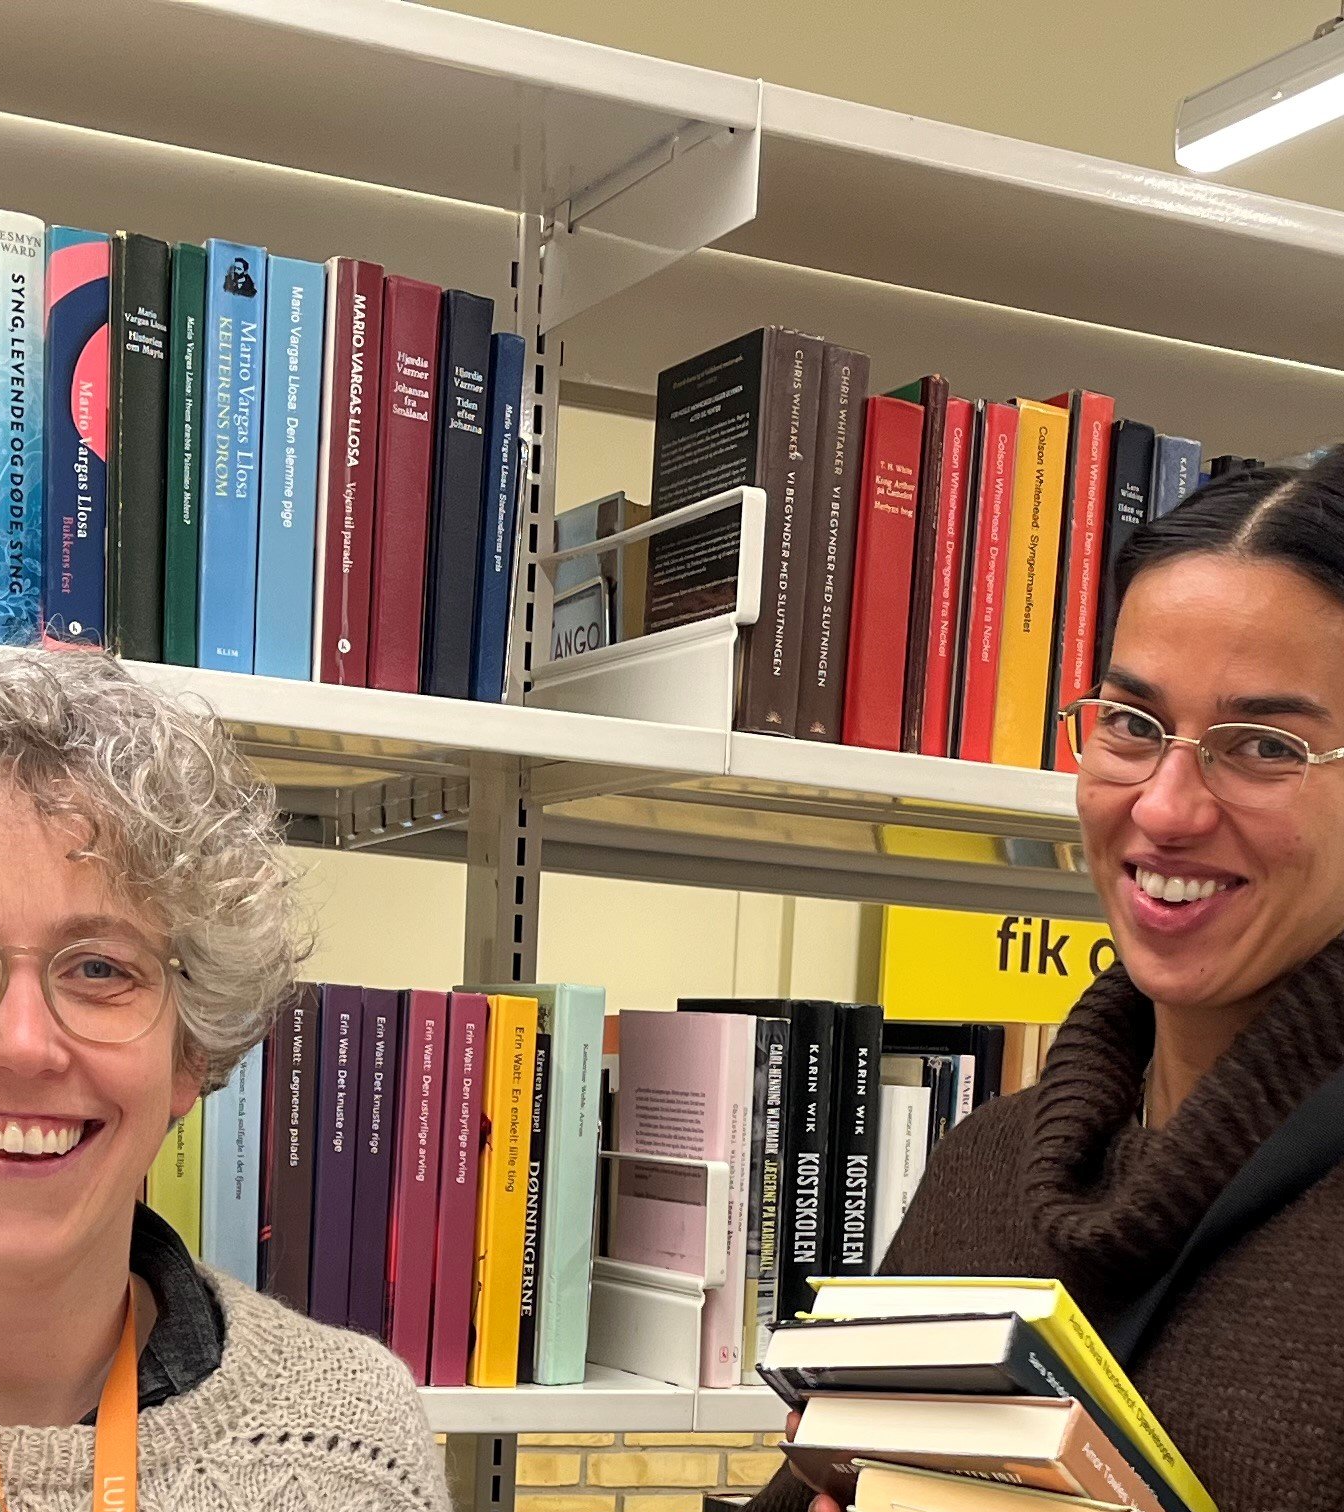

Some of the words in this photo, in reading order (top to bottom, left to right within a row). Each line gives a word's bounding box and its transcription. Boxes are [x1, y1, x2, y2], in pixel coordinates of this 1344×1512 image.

[794, 350, 805, 388] CHRIS
[788, 394, 803, 461] WHITAKER
[786, 471, 796, 485] VI
[780, 488, 795, 559] BEGYNDER
[778, 562, 790, 591] MED
[772, 592, 787, 677] SLUTNINGEN
[997, 916, 1068, 976] fik
[295, 1009, 303, 1032] Erin
[536, 1049, 546, 1091] Kirsten
[857, 1048, 867, 1095] KARIN
[292, 1070, 302, 1125] Løgnenes
[532, 1095, 544, 1133] Vaupel
[855, 1105, 865, 1135] WIK
[289, 1128, 299, 1167] palads
[843, 1155, 867, 1265] KOSTSKOLEN
[520, 1162, 540, 1316] DØNNINGERNE
